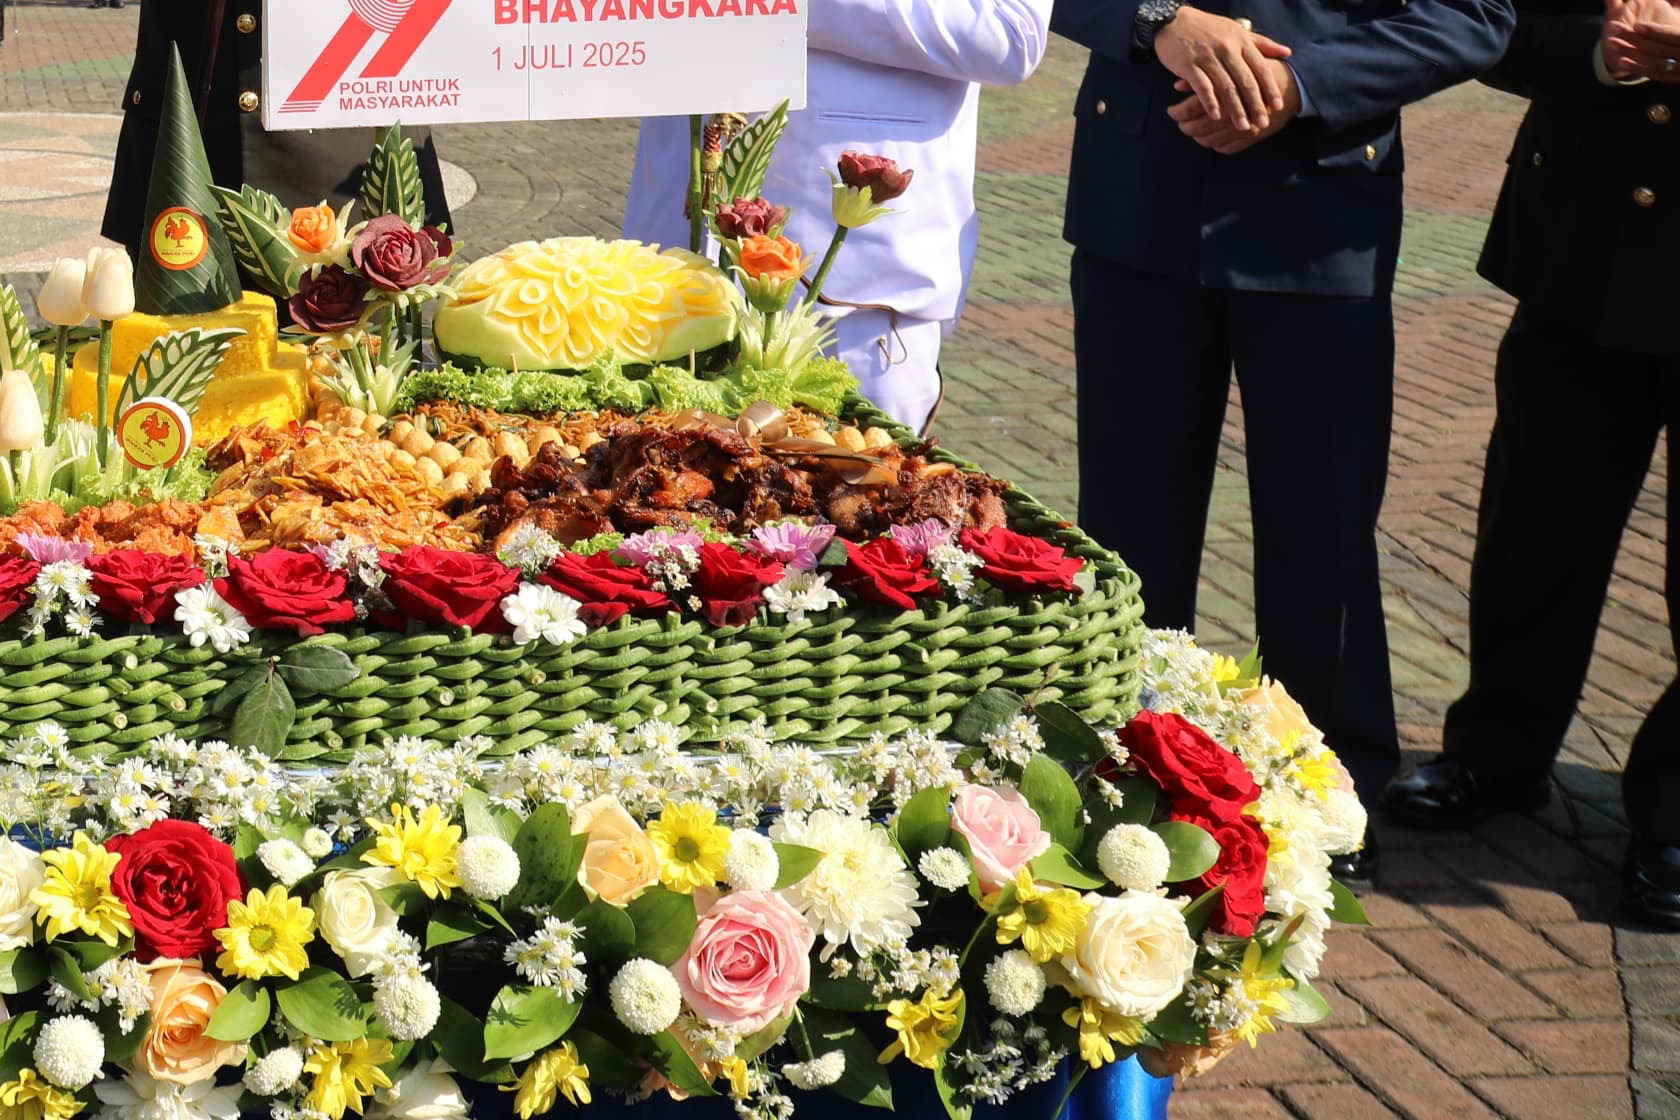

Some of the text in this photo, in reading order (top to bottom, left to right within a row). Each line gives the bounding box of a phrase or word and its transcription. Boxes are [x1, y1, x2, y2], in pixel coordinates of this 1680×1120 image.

[492, 41, 647, 71] 1 JULI 2025
[339, 78, 460, 95] POLRI UNTUK
[338, 93, 461, 111] MASYARAKAT
